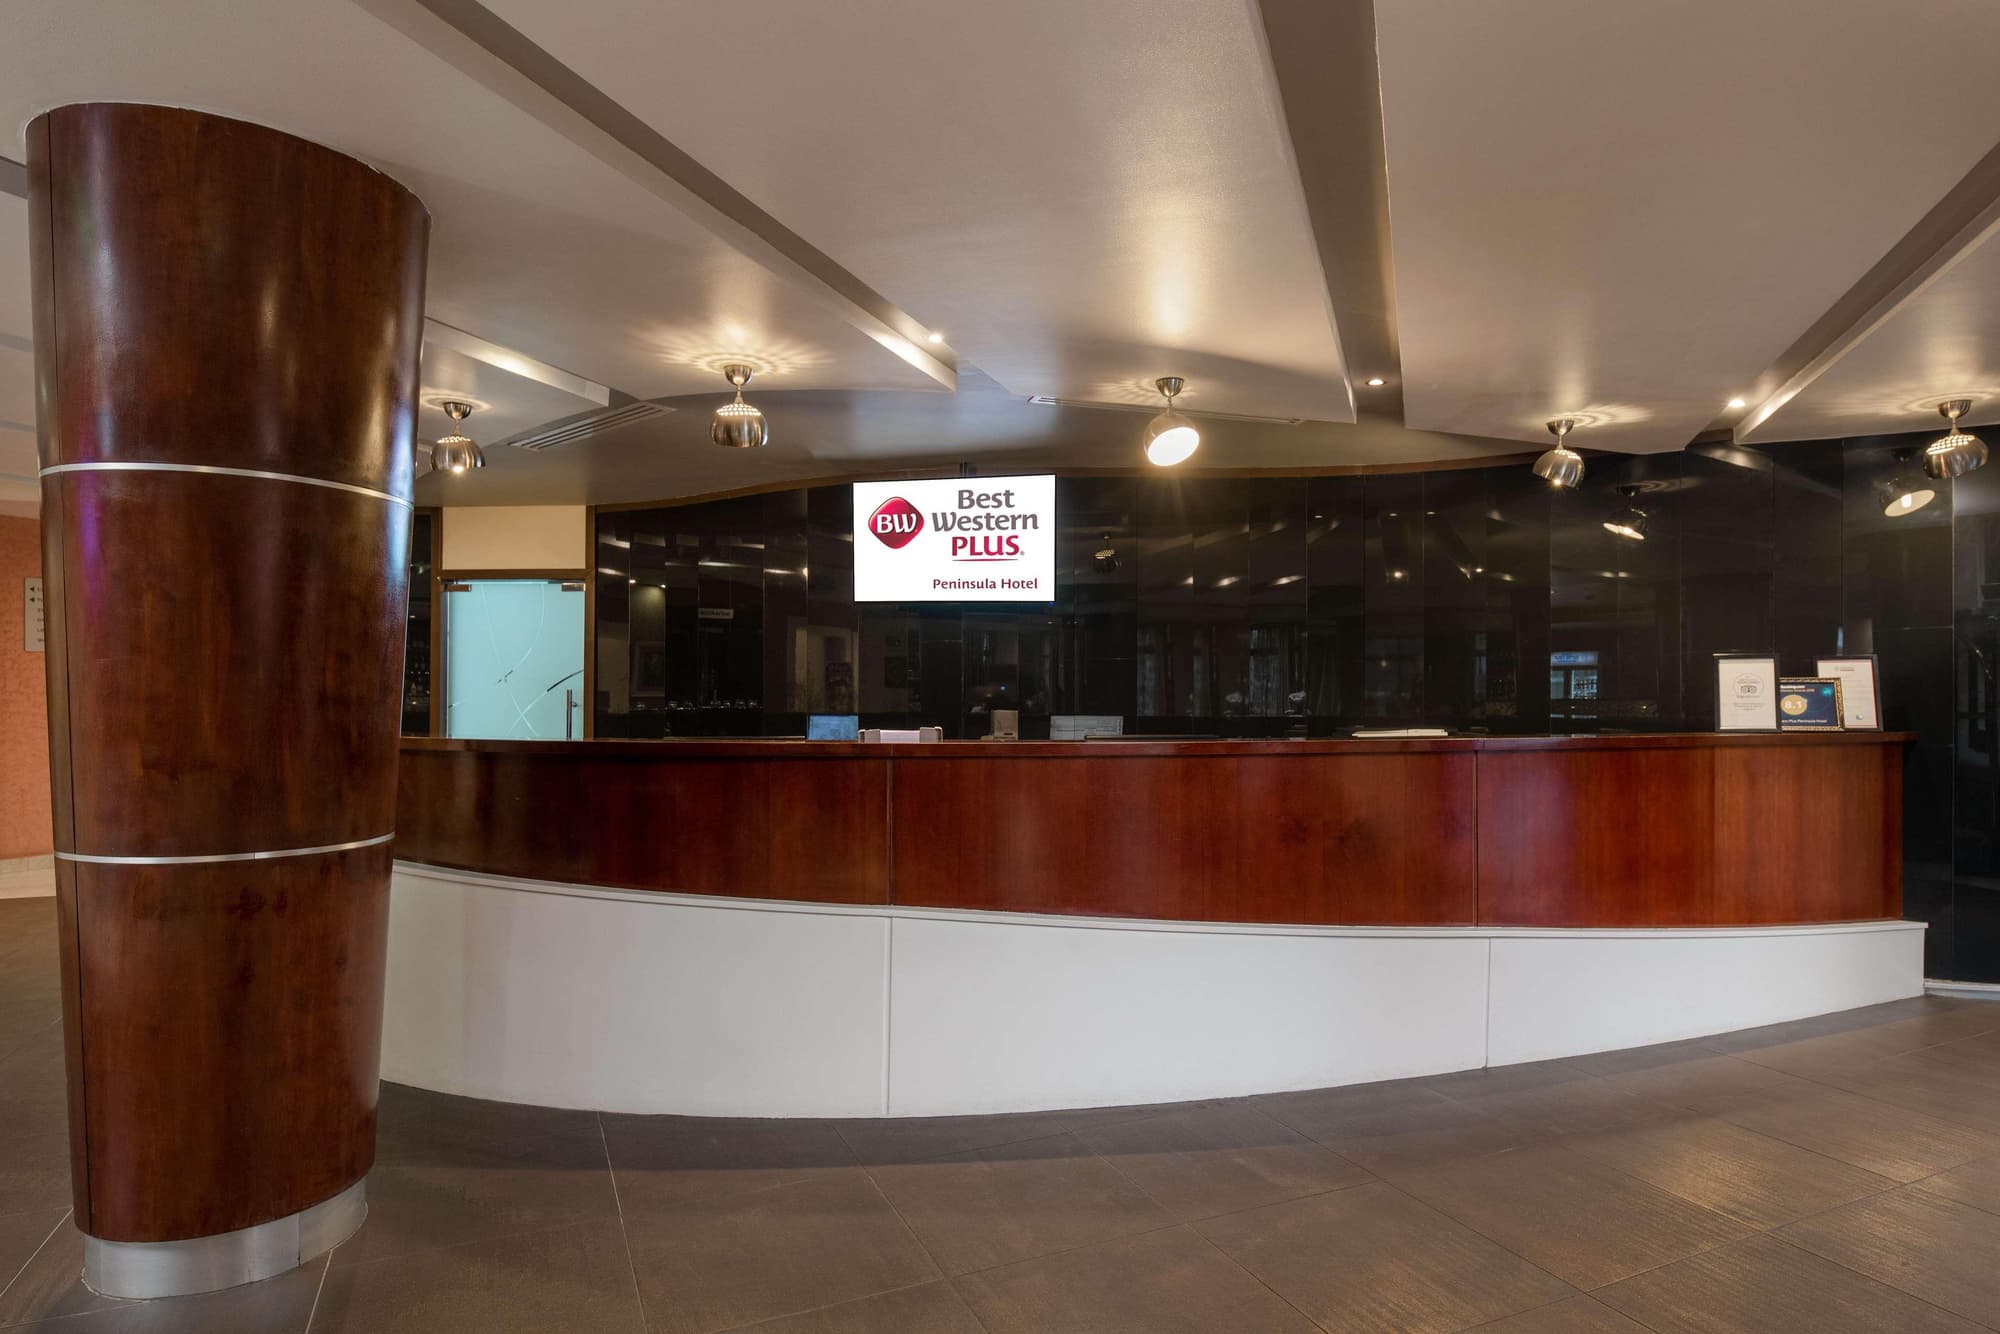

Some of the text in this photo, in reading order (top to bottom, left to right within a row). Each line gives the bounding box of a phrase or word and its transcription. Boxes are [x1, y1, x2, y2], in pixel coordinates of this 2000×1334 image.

[958, 489, 1015, 509] Best
[876, 513, 917, 535] BW
[932, 511, 1039, 532] Western
[933, 578, 1038, 590] Peninsula Hotel
